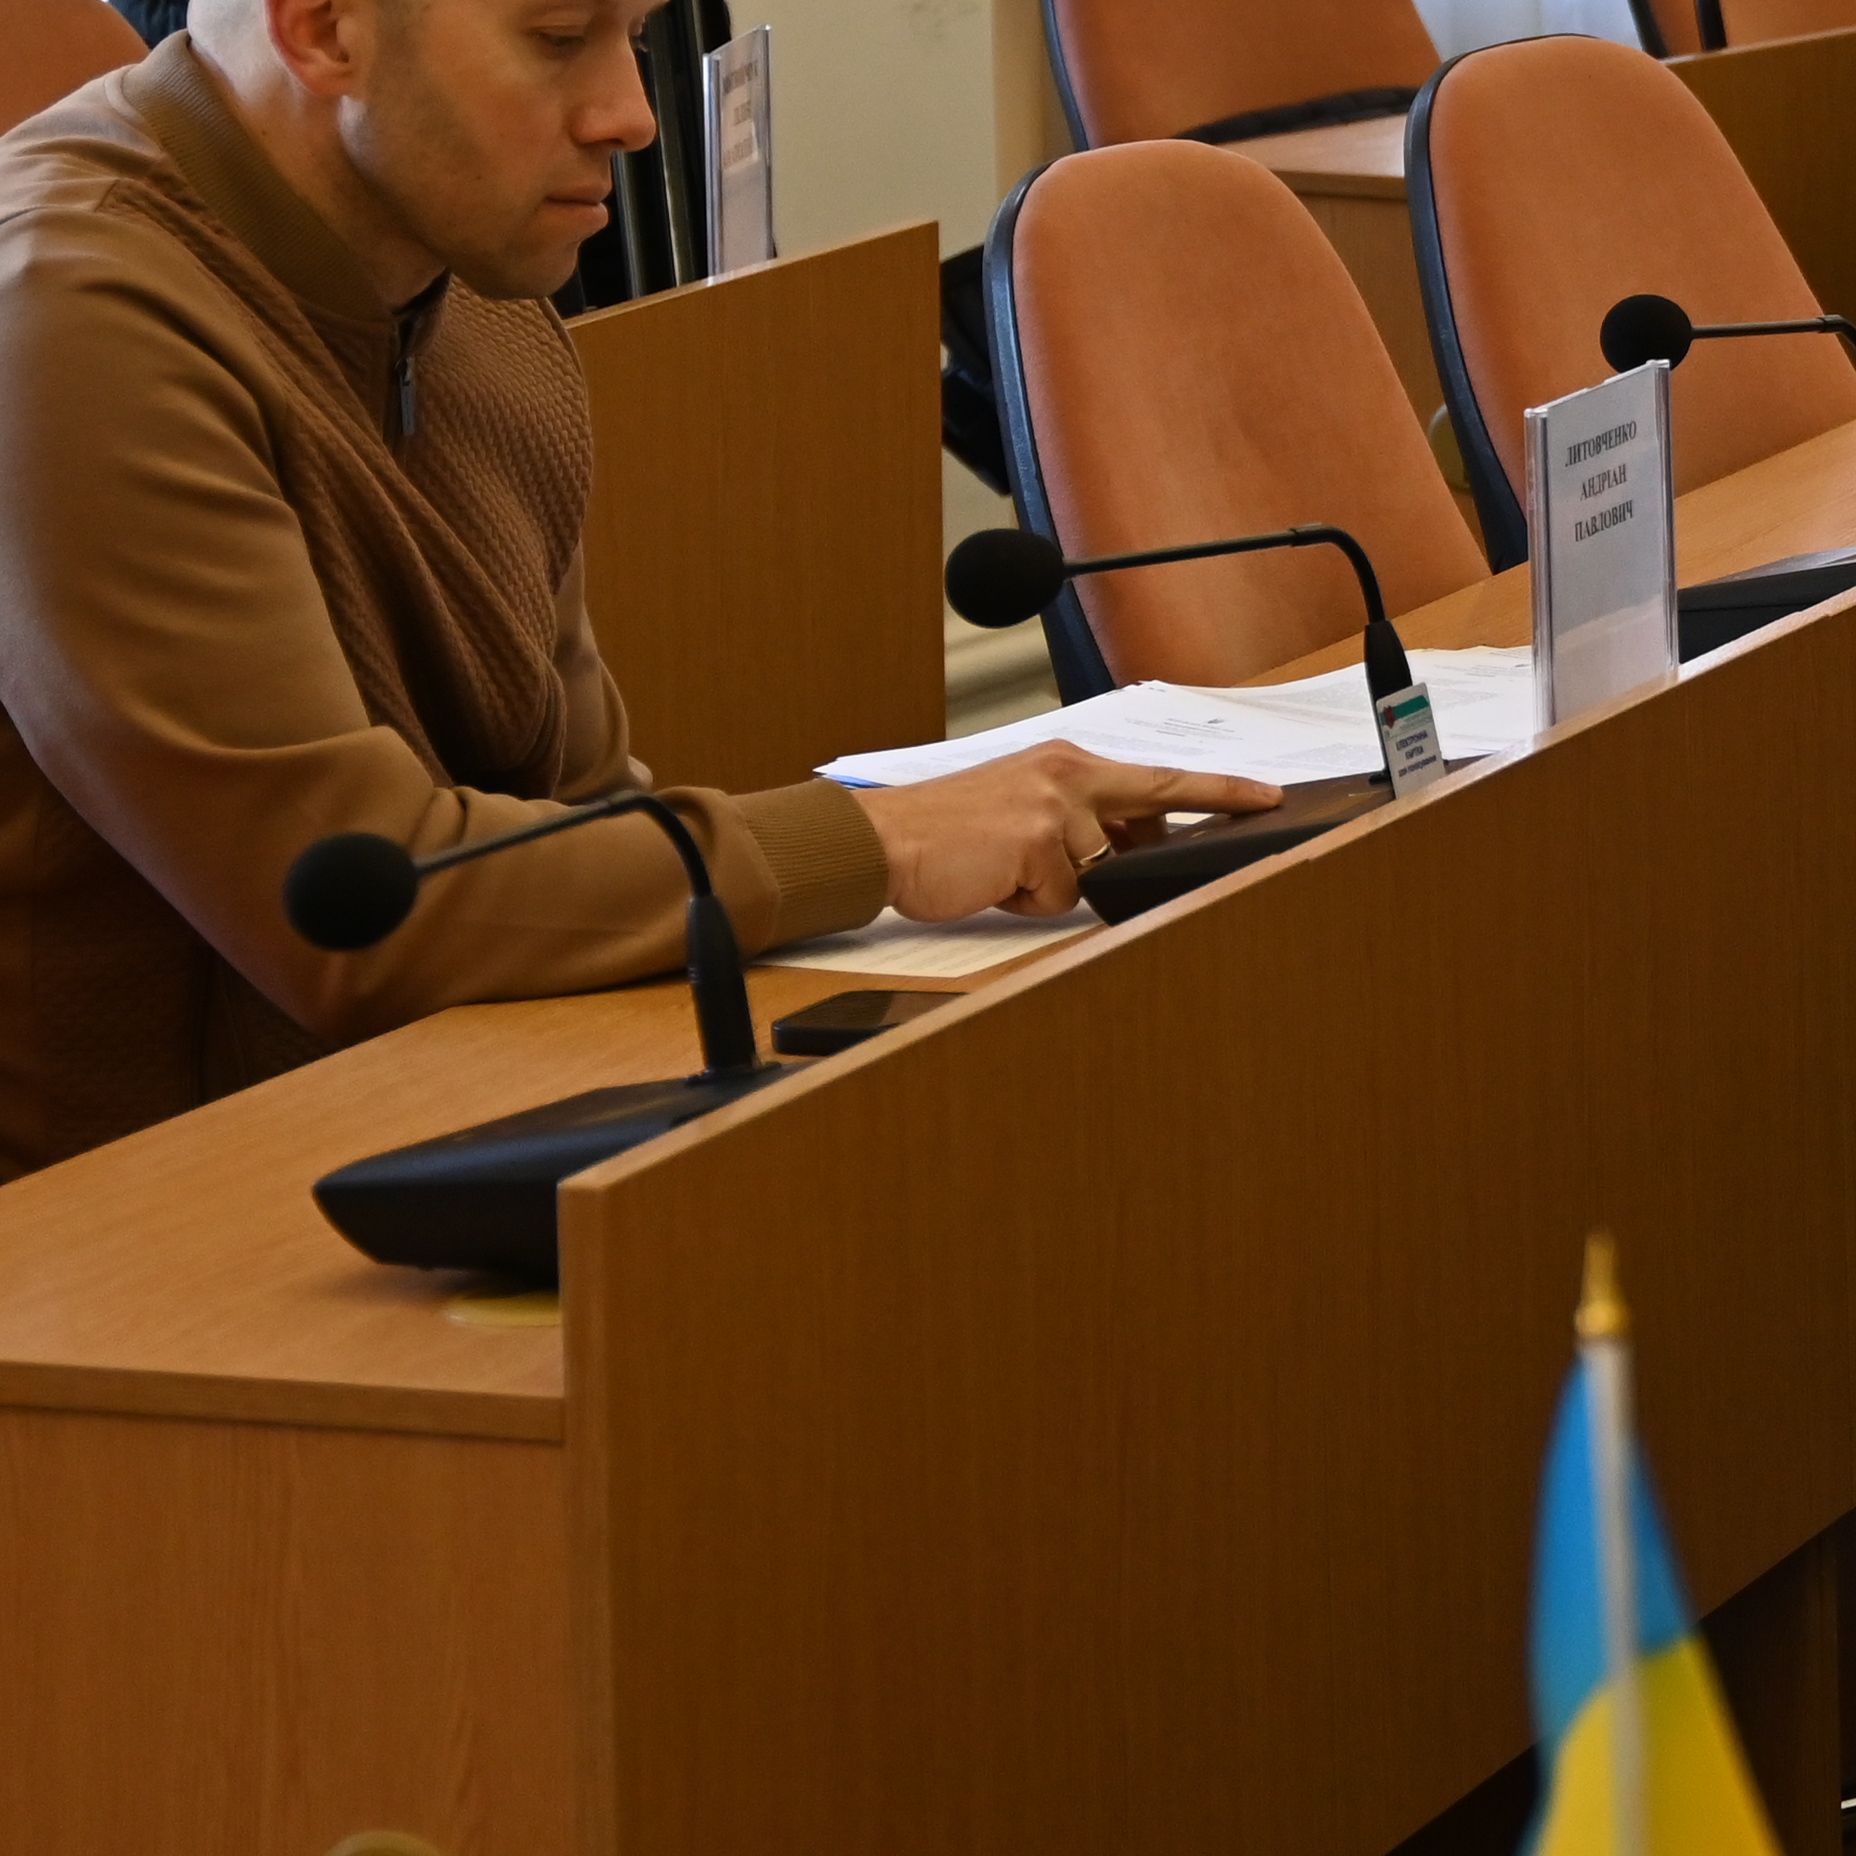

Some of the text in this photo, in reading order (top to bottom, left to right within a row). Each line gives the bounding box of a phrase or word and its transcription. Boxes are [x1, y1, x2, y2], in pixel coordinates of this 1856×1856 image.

[1565, 420, 1637, 467] ЛИТОВЧЕНКО
[1580, 463, 1628, 501] АНДРІАН
[1574, 499, 1634, 543] ПАВЛОВИЧ
